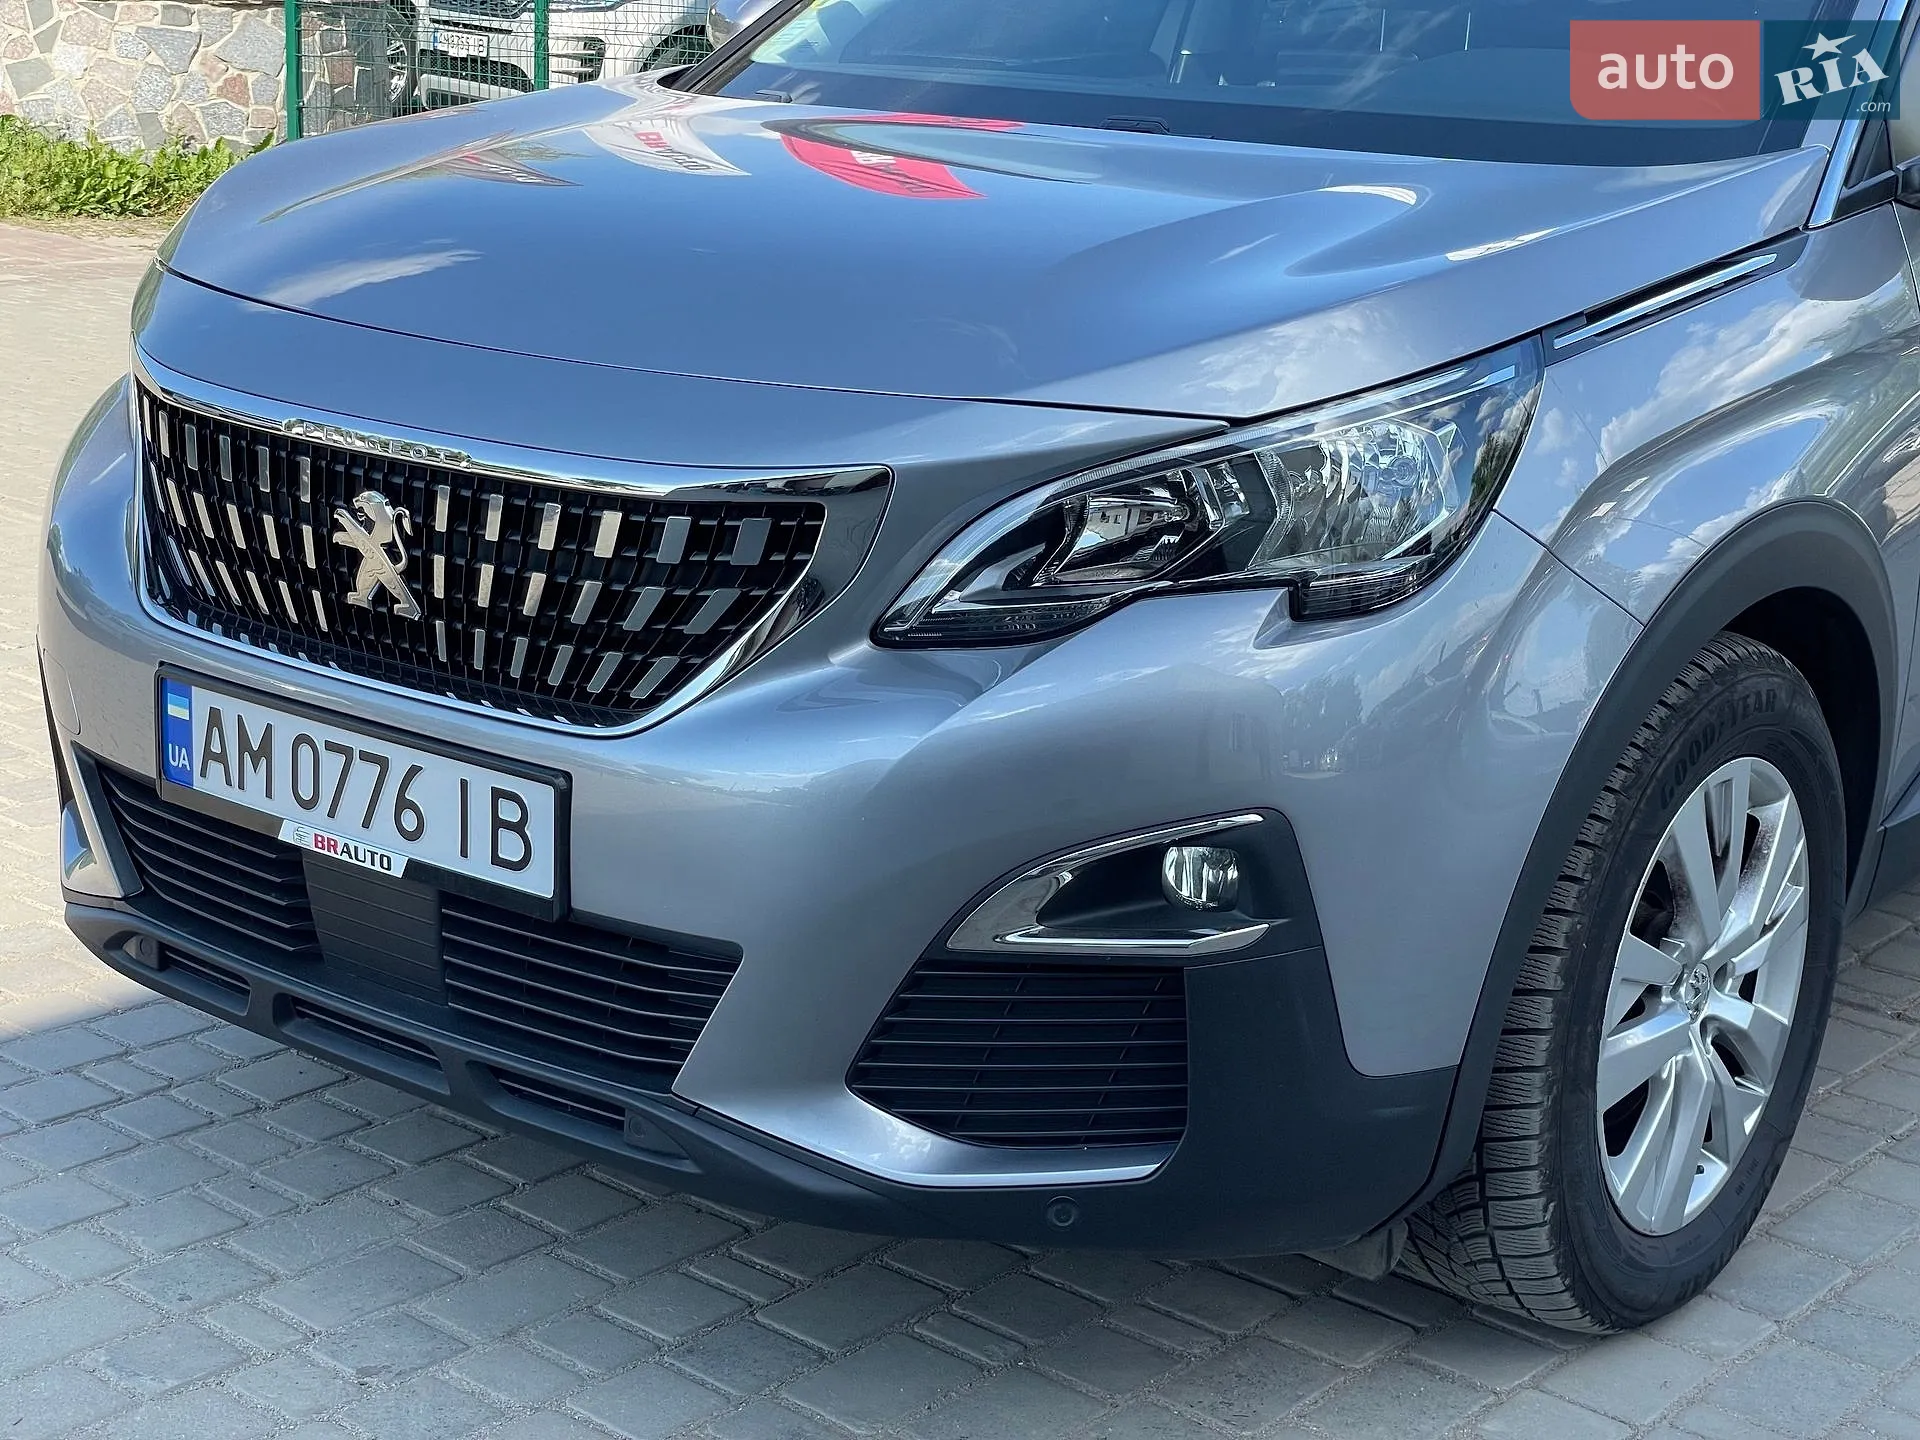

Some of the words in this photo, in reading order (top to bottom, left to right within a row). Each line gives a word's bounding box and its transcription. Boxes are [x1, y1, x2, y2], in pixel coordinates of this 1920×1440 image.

[168, 743, 192, 772] UA
[199, 706, 273, 800] AM
[291, 733, 425, 843] 0776
[460, 778, 533, 872] IB
[314, 832, 392, 872] BRAUTO
